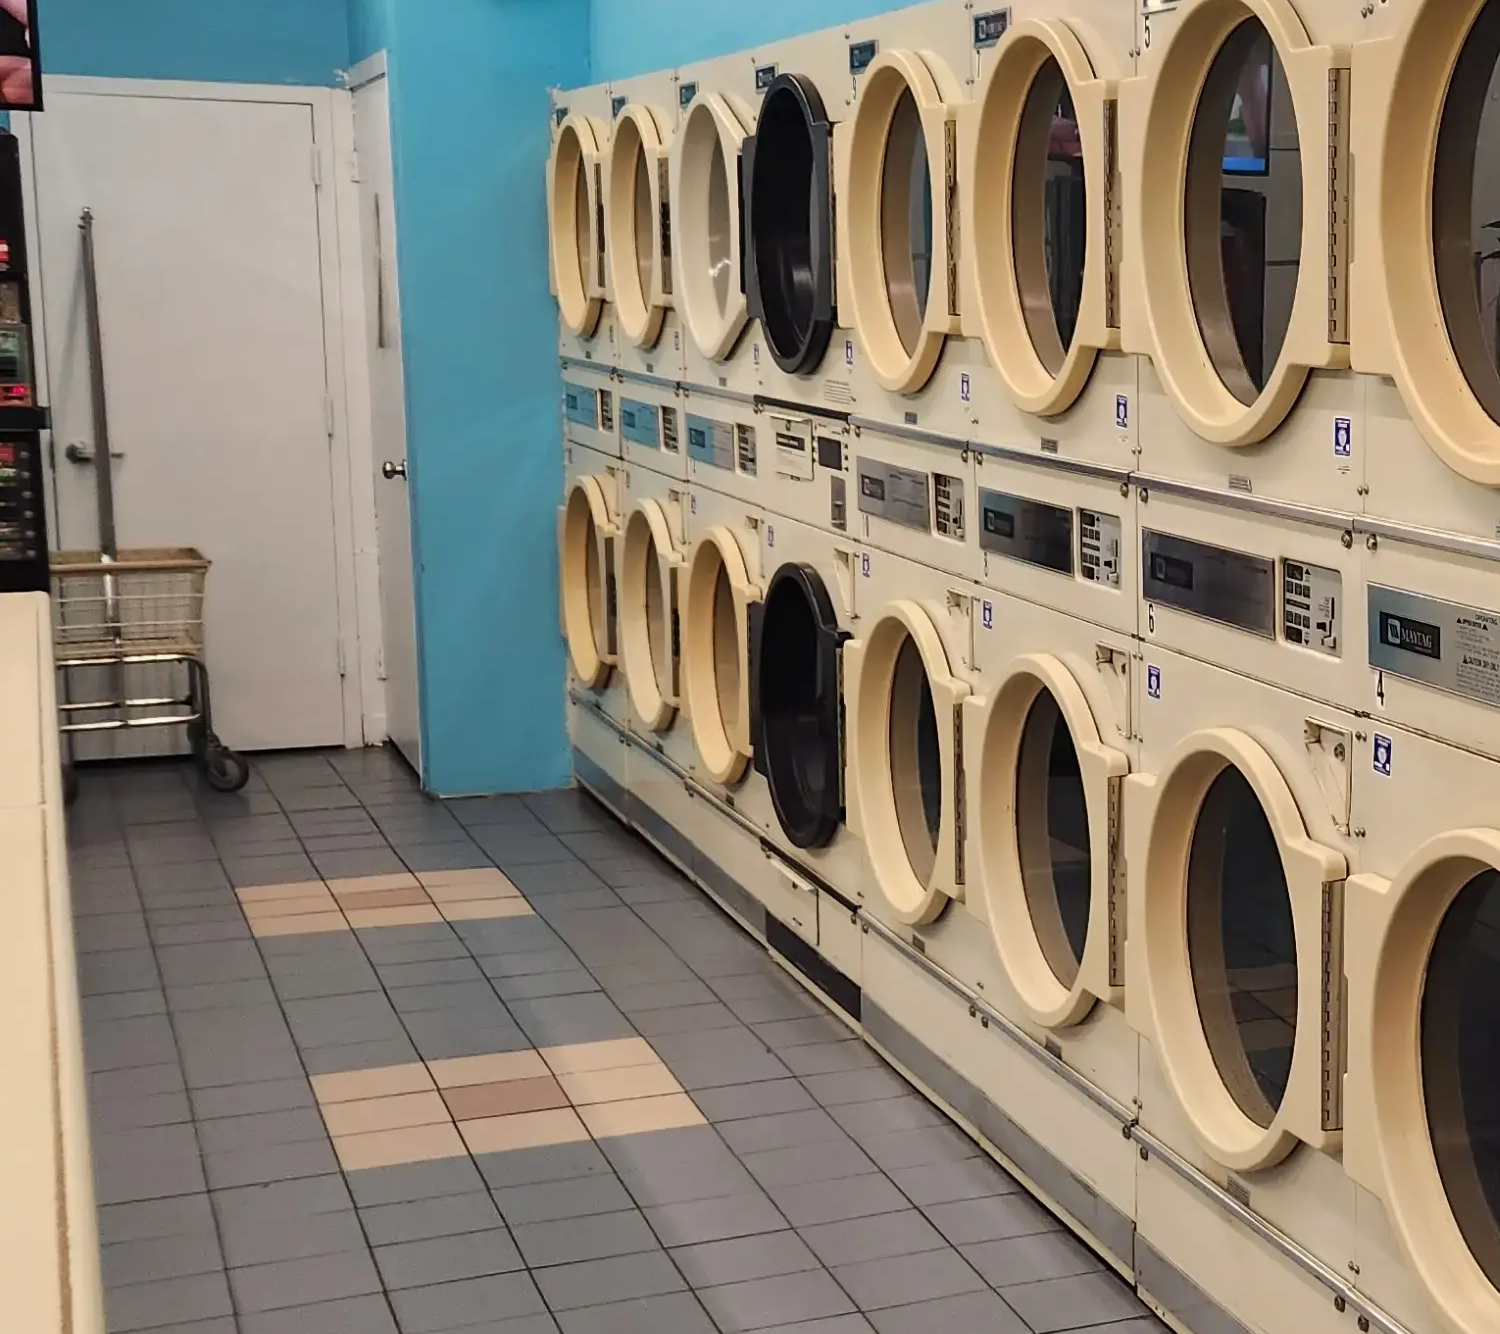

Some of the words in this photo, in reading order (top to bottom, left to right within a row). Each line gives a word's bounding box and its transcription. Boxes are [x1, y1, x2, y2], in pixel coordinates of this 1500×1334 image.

[1144, 15, 1150, 49] 5
[1148, 603, 1154, 633] 6
[1401, 627, 1432, 648] MAYTAG
[1377, 670, 1384, 707] 4
